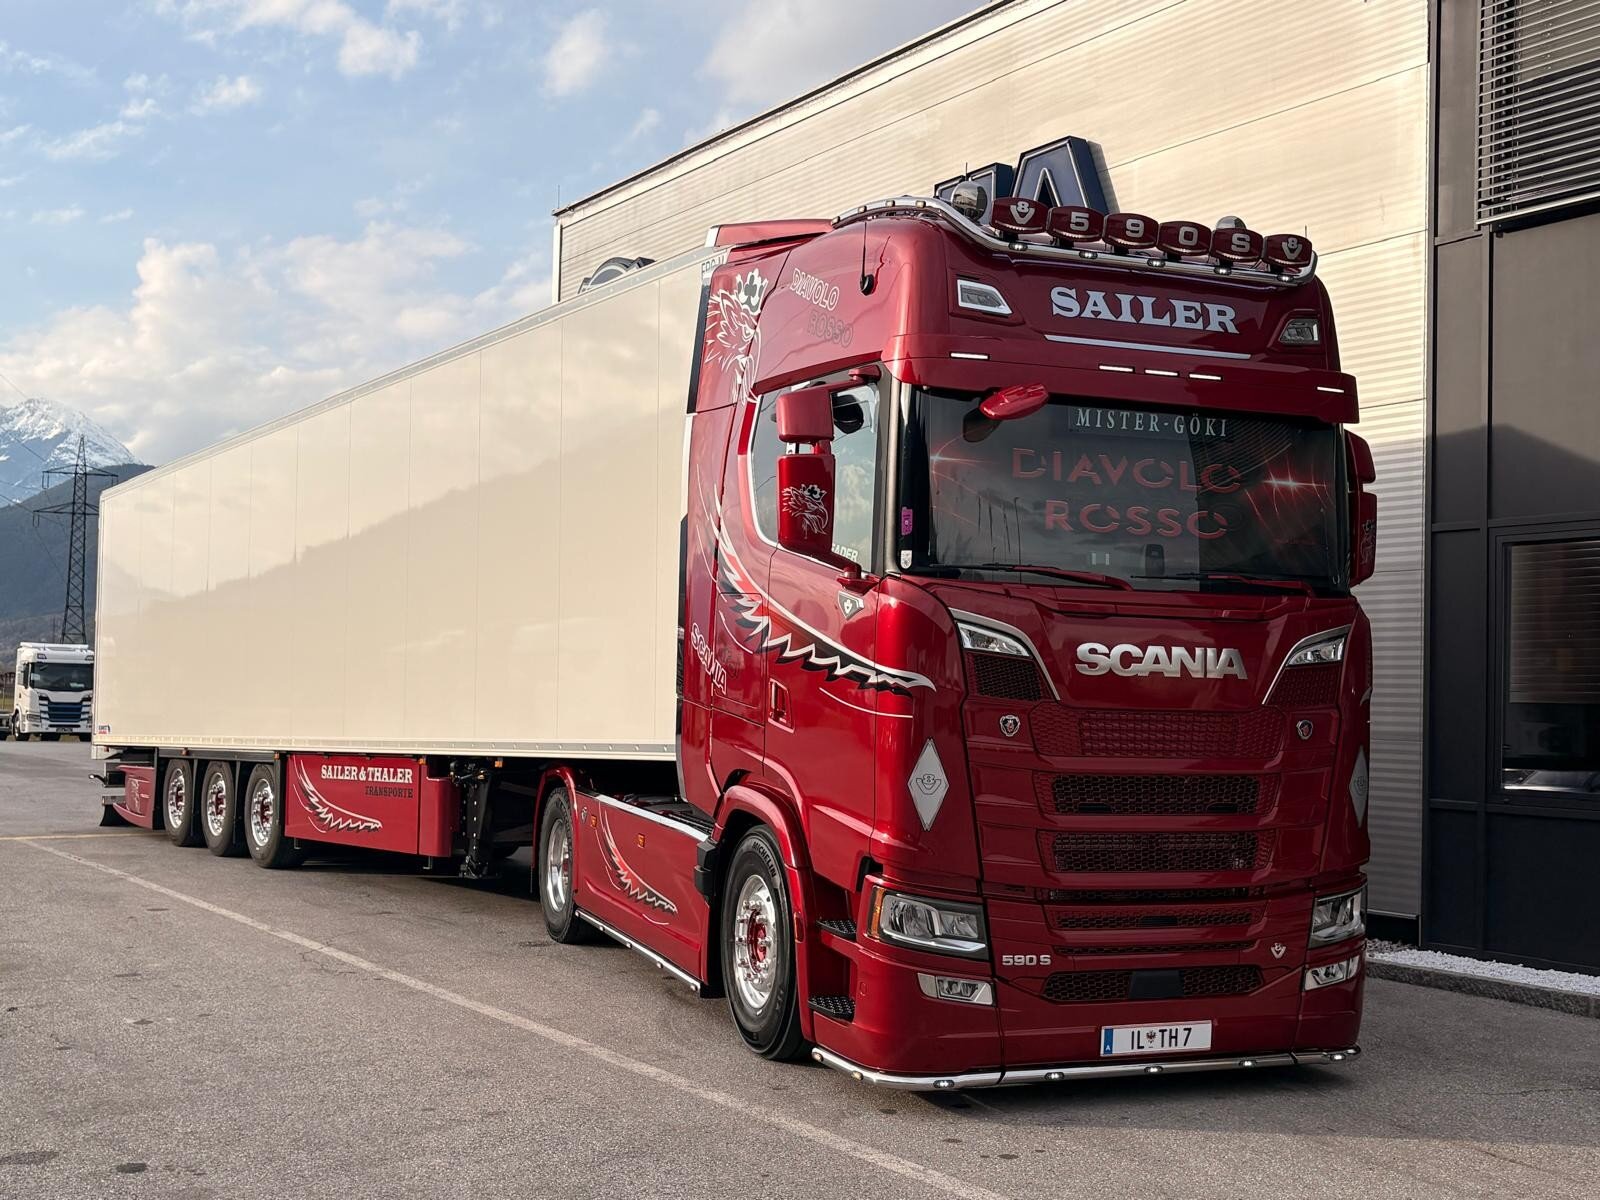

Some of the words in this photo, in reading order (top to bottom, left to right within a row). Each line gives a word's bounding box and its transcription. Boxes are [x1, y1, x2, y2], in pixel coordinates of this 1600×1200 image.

[789, 267, 840, 311] DIAVOLO
[808, 308, 853, 349] ROSSO
[1050, 286, 1240, 334] SAILER
[1076, 408, 1227, 437] MISTER-GÖKI
[1012, 447, 1241, 493] DIAVOLO
[1044, 499, 1228, 539] ROSSO
[691, 622, 727, 695] SCANIA
[1075, 642, 1248, 680] SCANIA
[365, 785, 413, 799] TRANSPORTE
[752, 841, 777, 878] MICHELIN
[1002, 954, 1037, 966] 590
